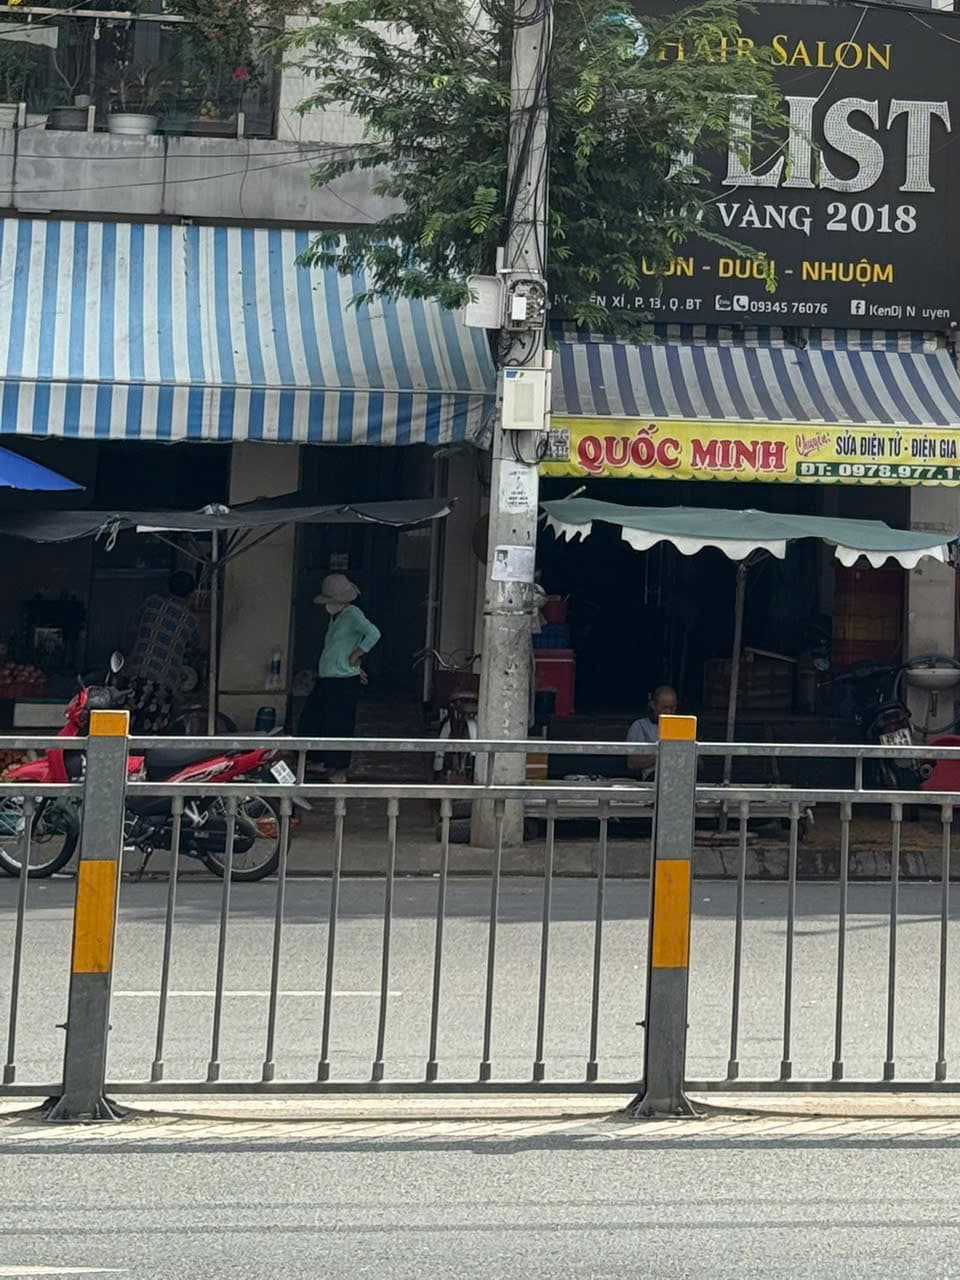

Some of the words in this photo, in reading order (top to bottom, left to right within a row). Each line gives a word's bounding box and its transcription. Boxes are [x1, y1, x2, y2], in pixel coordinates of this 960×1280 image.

[769, 34, 893, 70] SALON
[716, 199, 813, 237] VÀNG
[826, 202, 917, 233] 2018
[802, 257, 894, 288] NHUỘM
[750, 300, 788, 314] 09345
[792, 302, 828, 314] 76076
[577, 424, 682, 471] QUỐC
[690, 438, 787, 471] MINH
[836, 430, 856, 456] SỬA
[860, 433, 885, 460] ĐIỆN
[888, 431, 902, 456] TỬ
[911, 434, 936, 462] ĐIỆN
[940, 439, 957, 459] GIA
[801, 463, 831, 476] ĐT:
